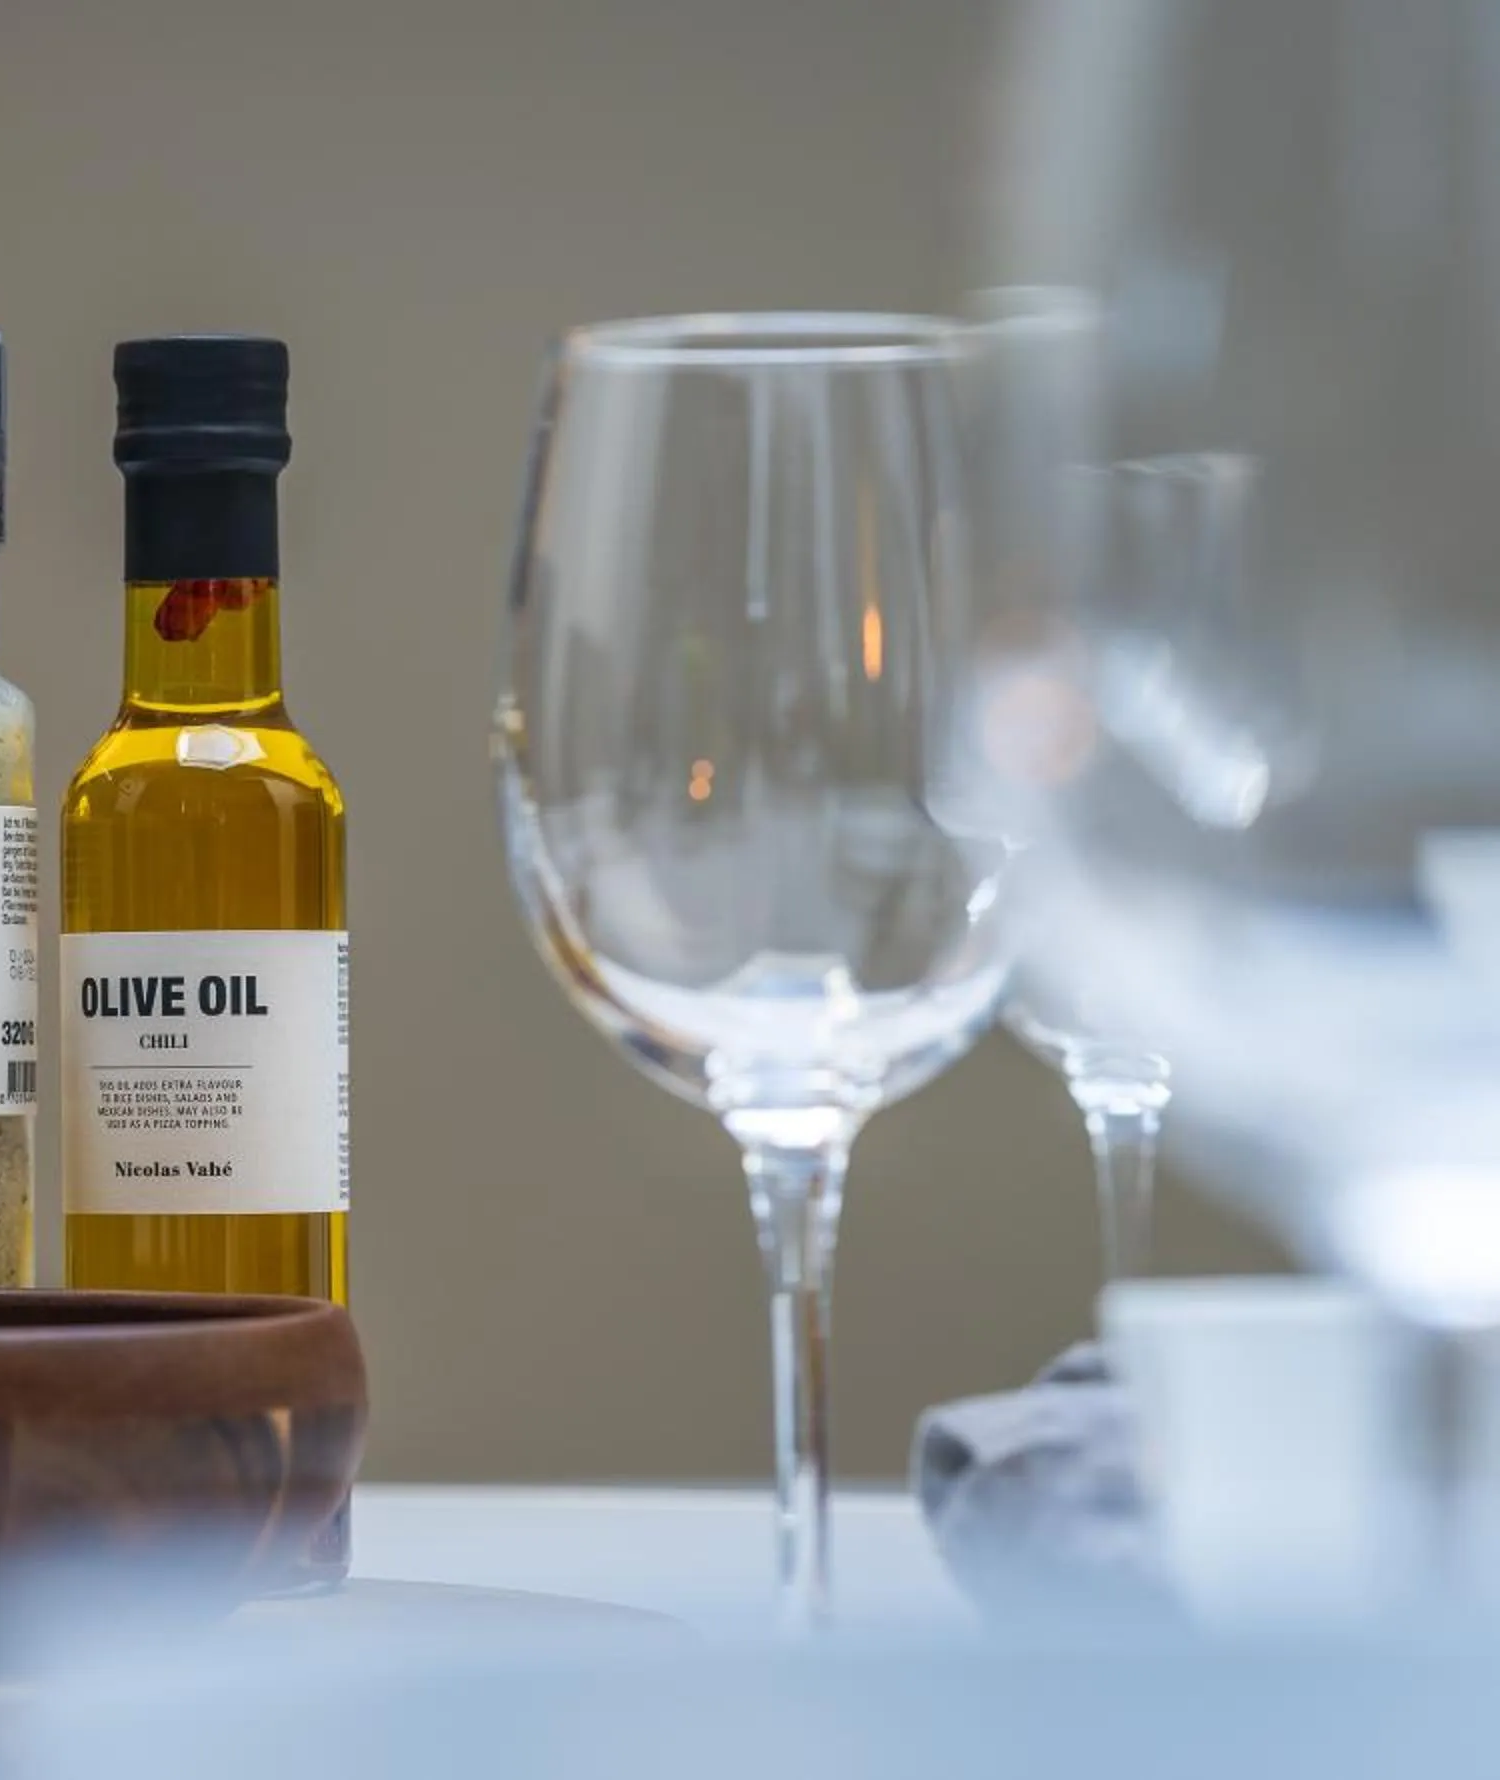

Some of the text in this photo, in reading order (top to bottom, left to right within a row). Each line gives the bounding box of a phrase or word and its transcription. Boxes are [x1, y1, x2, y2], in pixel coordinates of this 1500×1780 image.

[81, 975, 269, 1018] OLIVE OIL
[139, 1033, 189, 1050] CHILI
[161, 1079, 193, 1091] EXTRA
[196, 1079, 244, 1091] FLAVOUR
[174, 1093, 213, 1103] SALADS
[215, 1093, 238, 1103] AND
[97, 1105, 134, 1117] MEXICAN
[177, 1105, 198, 1116] MAY
[201, 1105, 228, 1116] ALSO
[231, 1105, 243, 1116] BE
[129, 1118, 142, 1129] AS
[143, 1118, 151, 1129] A
[153, 1118, 182, 1129] PIZZA
[114, 1159, 233, 1178] Nicolas Vahé
